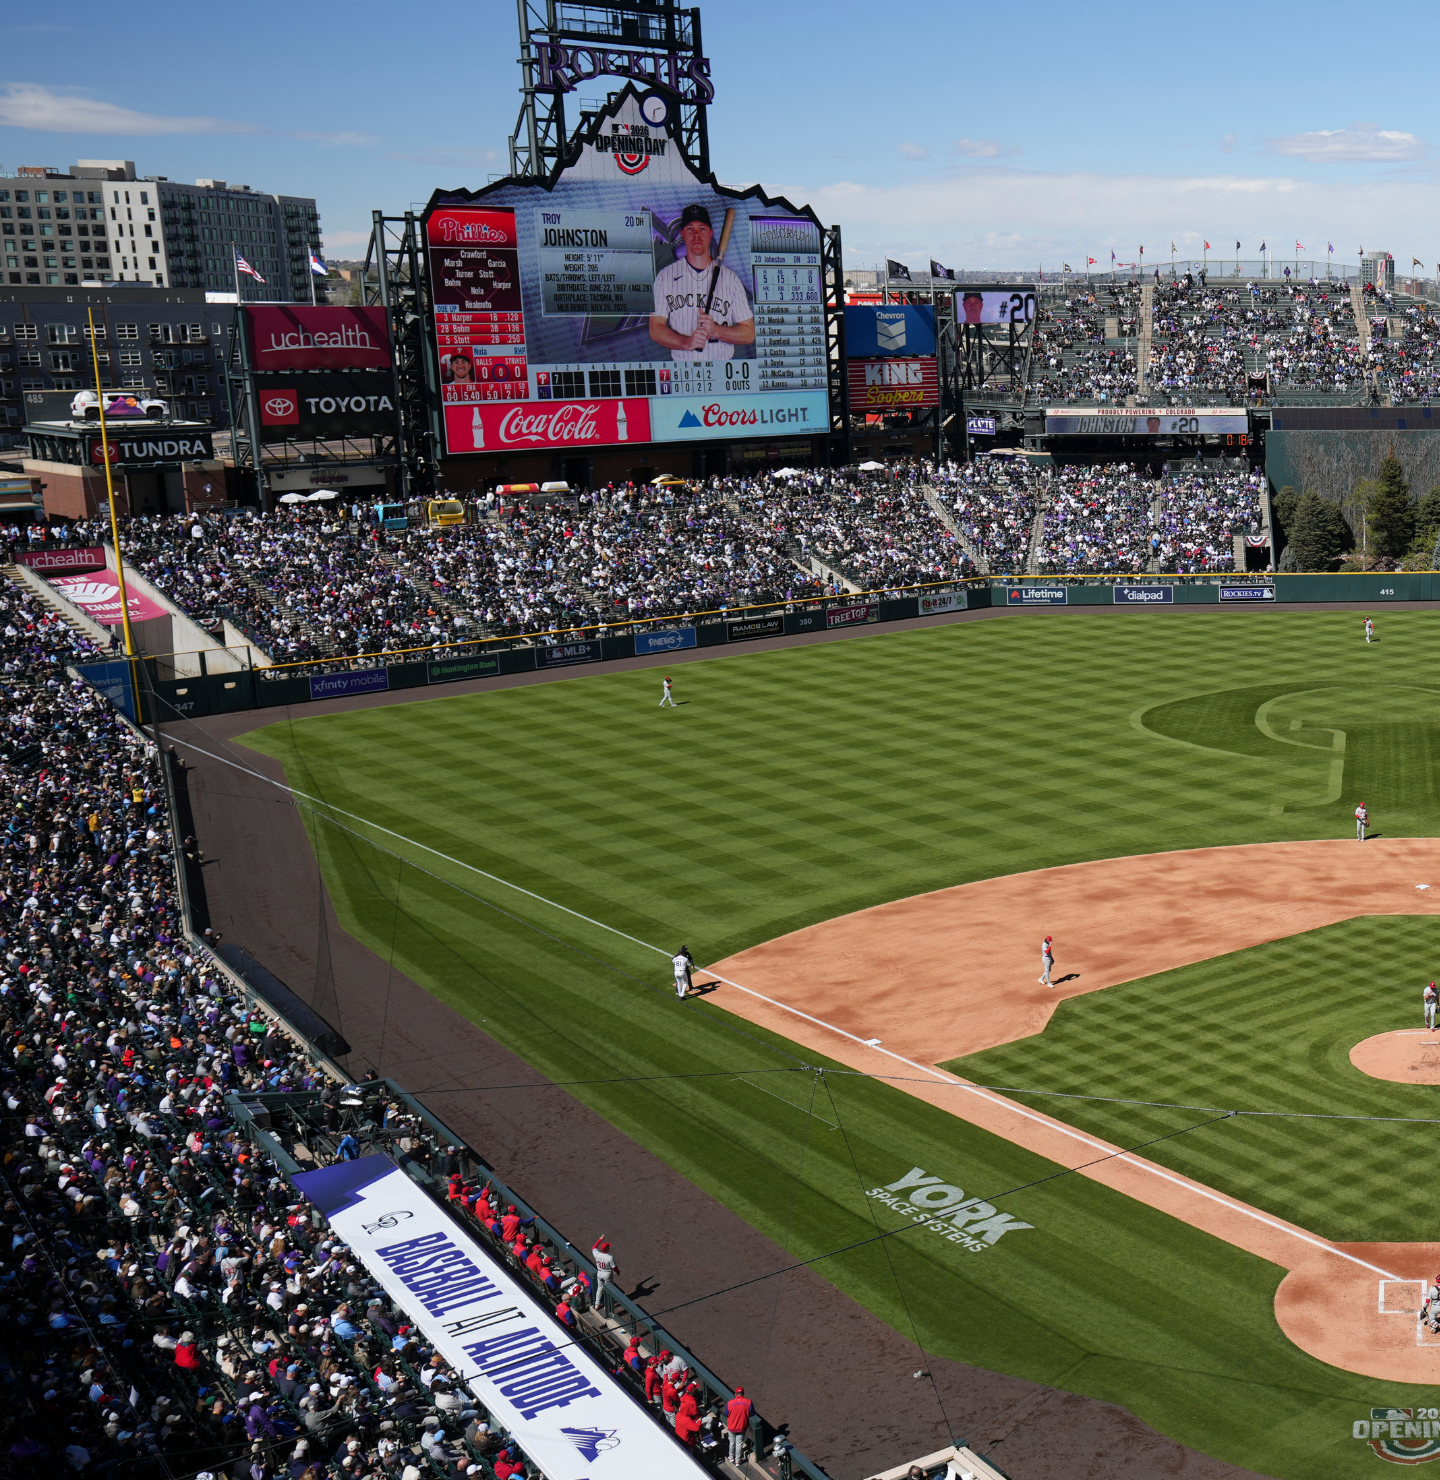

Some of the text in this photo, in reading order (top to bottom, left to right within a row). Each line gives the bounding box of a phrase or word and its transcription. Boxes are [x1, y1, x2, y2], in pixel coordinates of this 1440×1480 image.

[531, 41, 715, 105] ROCKIES
[630, 124, 649, 136] 2026
[595, 134, 644, 154] OPENING
[541, 212, 644, 227] TROY 20 DH
[438, 217, 507, 242] Phillies
[543, 228, 608, 248] JOHNSTON
[759, 227, 812, 244] COLORADO
[460, 249, 487, 259] Crawford
[564, 253, 586, 262] HEIGHT:
[764, 255, 786, 263] Johnston
[444, 258, 463, 267] Marsh
[487, 259, 507, 268] Garcia
[563, 263, 599, 272] WEIGHT: 205
[455, 269, 494, 278] Turner Stott
[545, 273, 616, 282] BATS/THROWS: LEFT/LEFT
[444, 278, 461, 287] Bohm
[492, 281, 512, 290] Harper
[470, 286, 484, 295] Nola
[437, 305, 448, 313] DUE
[464, 300, 492, 309] Realmuto
[999, 293, 1036, 323] #20
[451, 313, 519, 323] Harper .120
[875, 311, 905, 320] Chevron
[440, 324, 471, 333] 28 Bohm
[271, 324, 370, 349] uchealth
[453, 335, 521, 344] Stott .250
[473, 347, 488, 356] Nola
[475, 357, 526, 366] BALLS STRIKES
[864, 363, 923, 386] KING
[732, 380, 750, 391] OUTS
[26, 394, 43, 404] 485
[463, 390, 498, 401] 5.40 5.0
[865, 385, 924, 408] Soopers
[305, 395, 394, 414] TOYOTA
[701, 403, 809, 427] Coors LIGHT
[499, 404, 601, 443] Coca-Cola
[968, 418, 994, 429] PLATTE
[1075, 417, 1199, 433] JOHNSTON #20
[1226, 434, 1248, 446] 0:18
[120, 440, 207, 458] TUNDRA
[25, 549, 95, 567] uchealth
[65, 576, 91, 584] THE
[1022, 588, 1064, 599] Lifetime
[1127, 590, 1163, 601] dialpad
[1379, 588, 1395, 596] 415
[732, 620, 779, 632] RAMOS LAW
[799, 617, 813, 626] 390
[563, 645, 592, 657] MLB+
[441, 660, 497, 675] Huntington Bank
[313, 674, 386, 693] xfinity mobile
[174, 701, 195, 712] 347
[883, 1166, 1036, 1245] YORK
[865, 1187, 989, 1252] SPACE SYSTEMS
[374, 1231, 603, 1421] BASEBALL AT ALTITUDE
